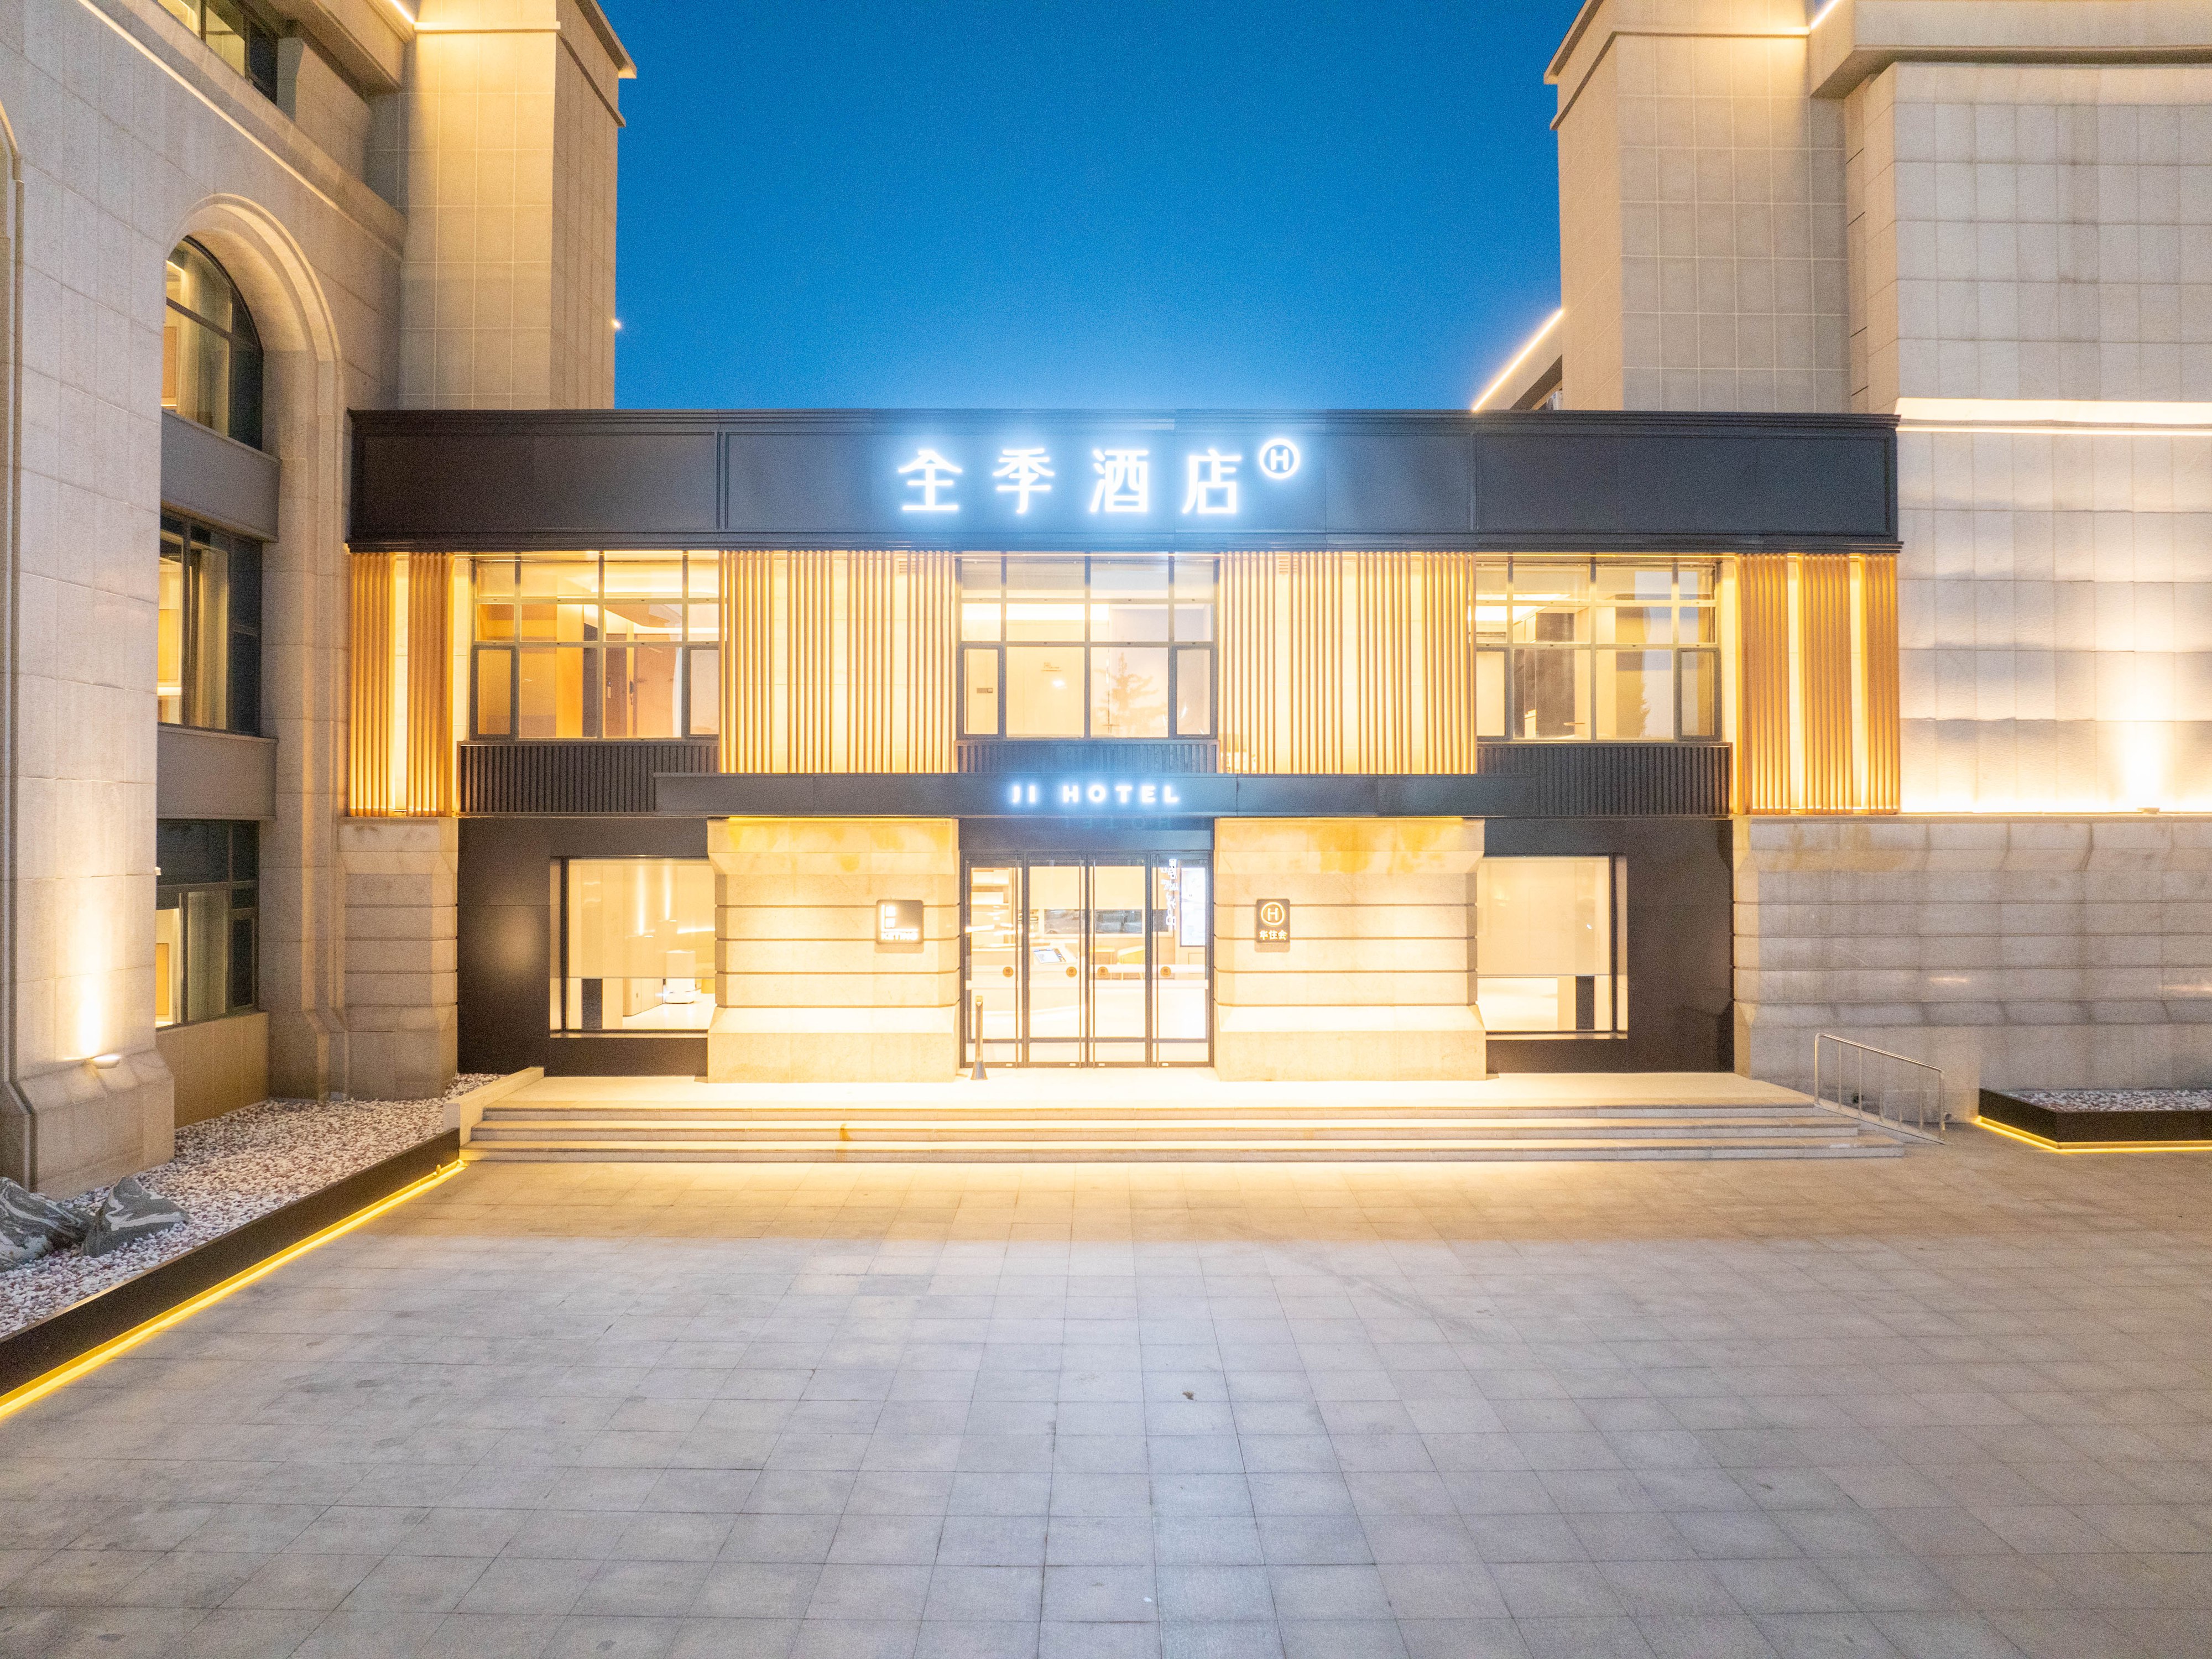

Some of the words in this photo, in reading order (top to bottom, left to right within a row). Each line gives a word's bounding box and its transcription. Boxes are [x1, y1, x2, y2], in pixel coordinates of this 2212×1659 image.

[898, 447, 1241, 514] 全季酒店
[1012, 785, 1036, 804] JI
[1062, 784, 1178, 804] HOTEL
